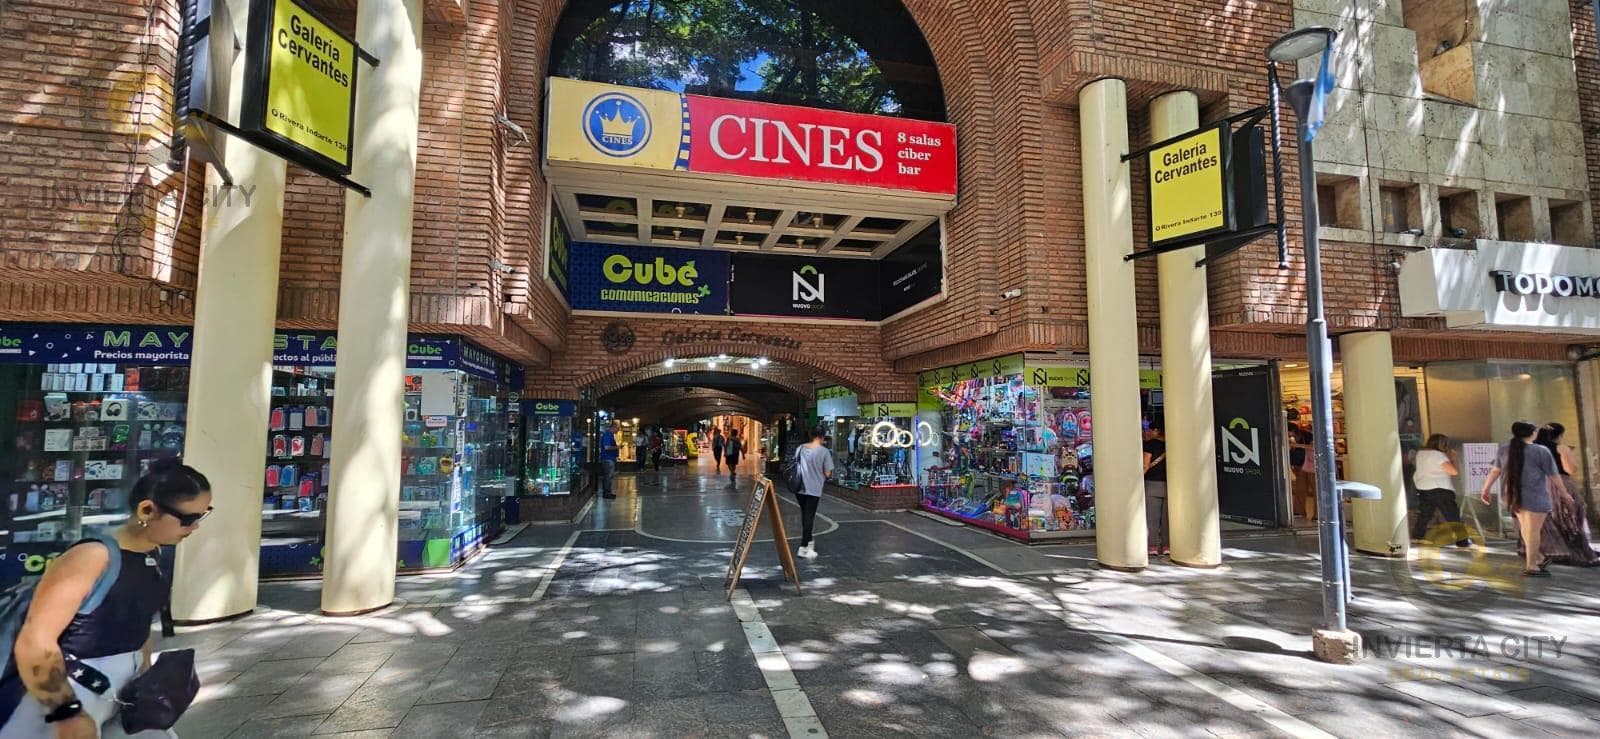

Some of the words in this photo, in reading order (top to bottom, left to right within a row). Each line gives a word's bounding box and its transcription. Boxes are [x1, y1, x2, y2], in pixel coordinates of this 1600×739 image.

[278, 28, 348, 88] Cervantes
[279, 112, 304, 131] Rivera
[306, 126, 334, 145] Indarte
[601, 136, 633, 145] CINES
[709, 114, 884, 173] CINES
[897, 131, 907, 143] 8
[909, 133, 942, 147] salas
[897, 147, 932, 161] ciber
[897, 161, 922, 175] bar
[1154, 156, 1218, 184] Cervantes
[1160, 221, 1182, 231] Rivera
[602, 254, 699, 287] Cube
[600, 288, 699, 304] comunicaciones
[94, 350, 133, 359] Precios
[135, 351, 189, 361] mayorista
[300, 353, 310, 361] al
[311, 352, 337, 363] públi
[409, 344, 443, 355] Cube
[535, 402, 560, 411] Cube
[1223, 466, 1244, 474] NUOVO
